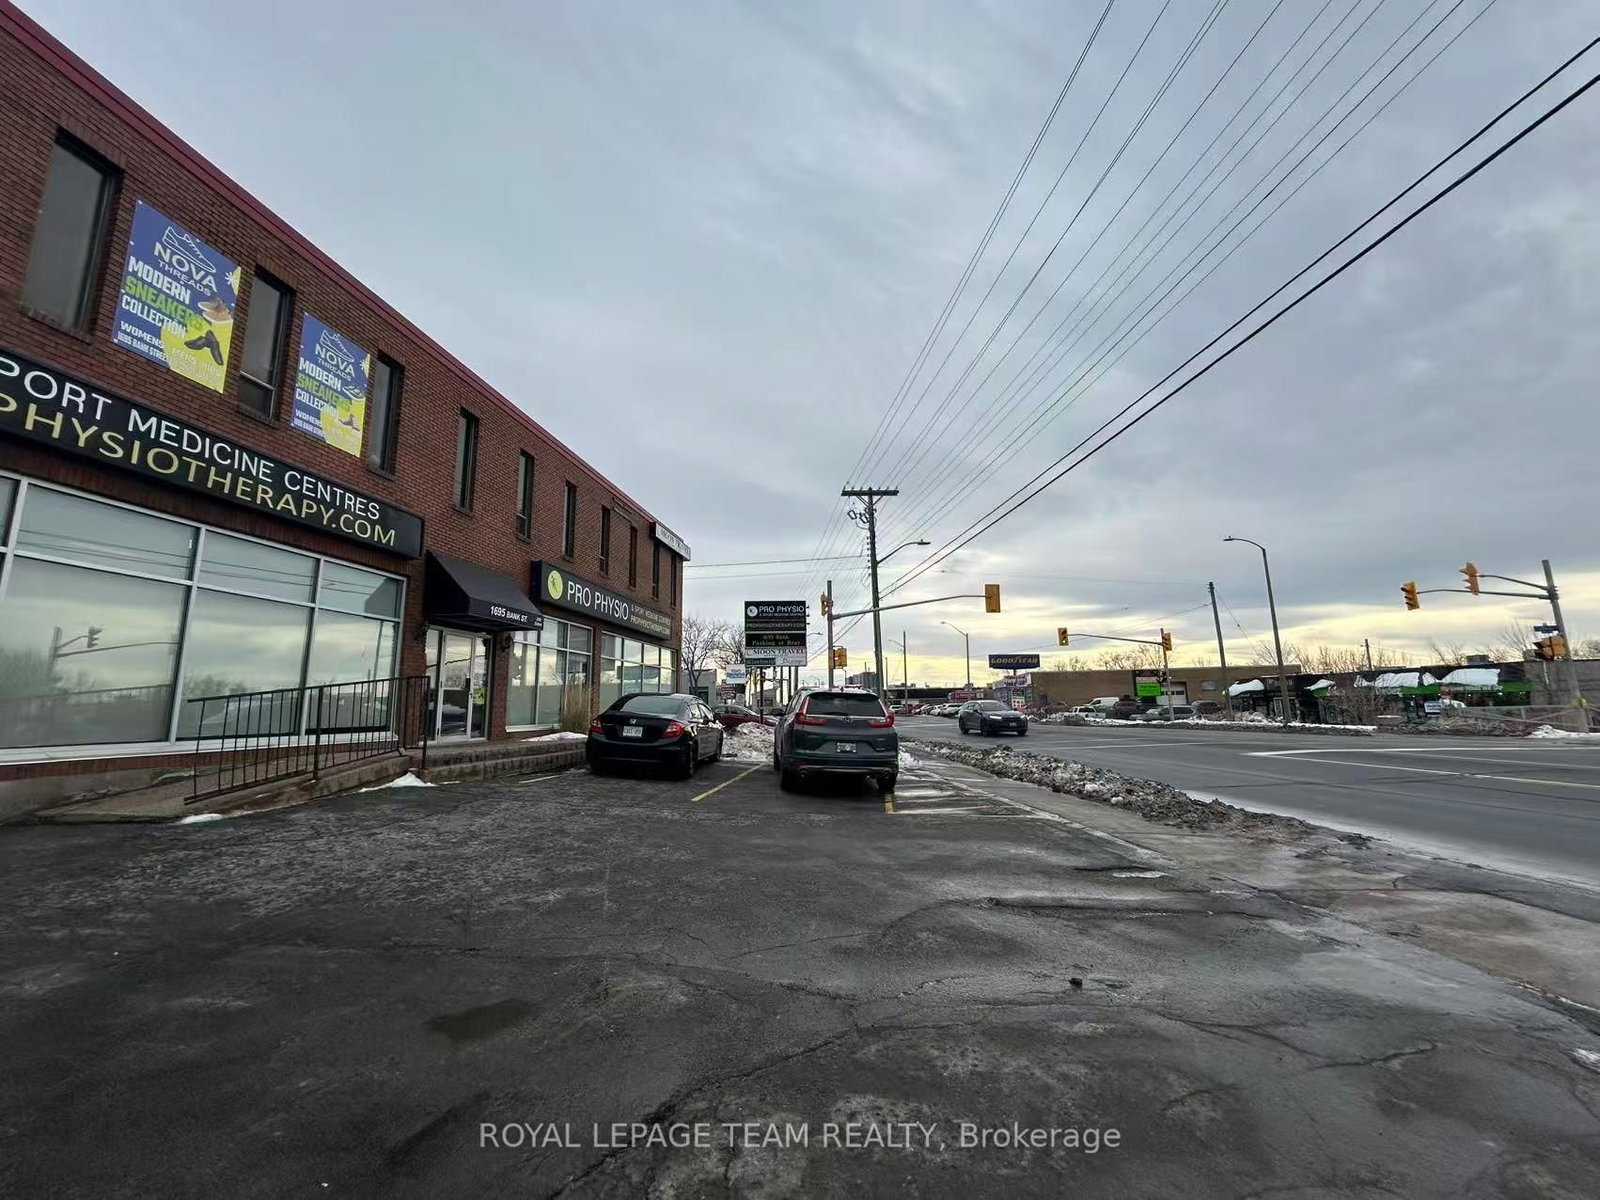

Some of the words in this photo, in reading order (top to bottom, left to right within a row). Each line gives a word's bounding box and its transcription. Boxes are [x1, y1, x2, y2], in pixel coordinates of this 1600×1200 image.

[128, 256, 191, 304] MODERN
[154, 242, 217, 292] NOVA
[158, 259, 212, 296] THREADS
[121, 295, 187, 339] COLLECTION
[124, 275, 206, 333] SNEAKERS
[120, 320, 164, 349] WOMENS
[132, 337, 150, 356] BANK
[299, 357, 342, 391] MODERN
[315, 343, 356, 377] NOVA
[317, 357, 352, 382] THREADS
[295, 388, 338, 418] COLLECTION
[297, 373, 353, 412] SNEAKERS
[295, 409, 322, 428] WOMENS
[128, 408, 275, 483] MEDICINE
[284, 470, 380, 520] CENTRES
[490, 605, 507, 618] 1695
[506, 611, 521, 621] BANK
[567, 580, 591, 607] PRO
[594, 591, 629, 621] PHYSIO
